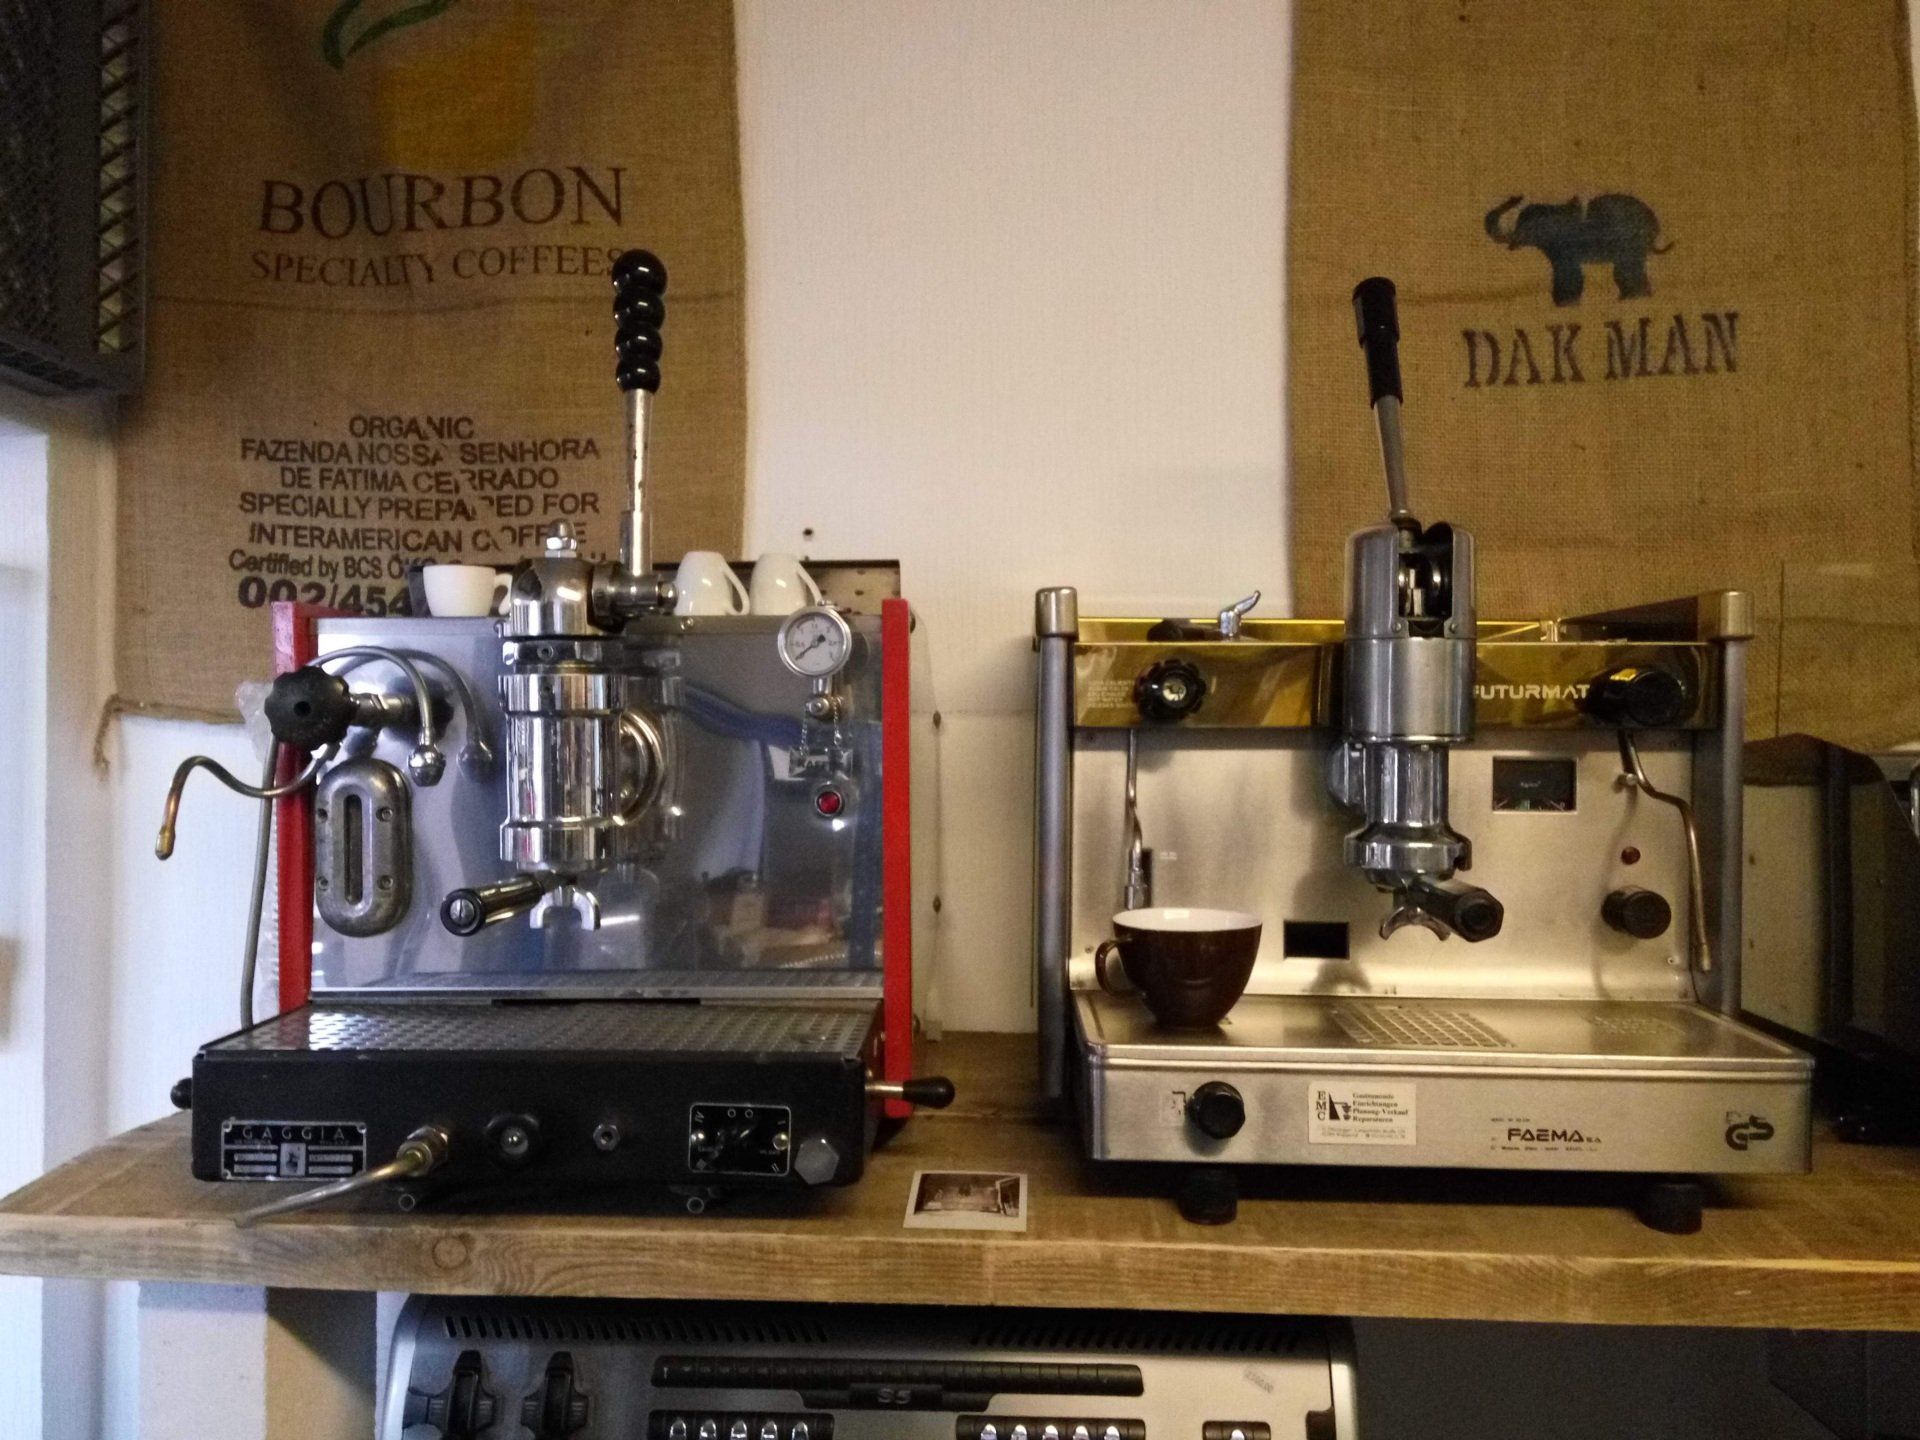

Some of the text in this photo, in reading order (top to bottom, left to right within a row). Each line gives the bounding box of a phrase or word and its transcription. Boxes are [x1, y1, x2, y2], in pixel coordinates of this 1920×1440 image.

[259, 165, 628, 240] BOURBON
[251, 248, 439, 288] SPECIALTY
[1461, 310, 1740, 389] DAK MAN
[349, 415, 475, 440] ORGANIC
[240, 438, 353, 465] FAZENDA
[459, 437, 600, 465] SENHORA
[279, 466, 560, 494] DE FATIMA CERRADO
[239, 492, 372, 519] SPECIALLY
[542, 491, 600, 516] FOR
[471, 522, 587, 552] COFFE
[229, 547, 313, 578] Certified
[318, 554, 340, 584] by
[343, 556, 383, 580] BCS
[242, 1126, 345, 1140] GAGGIA
[1507, 1128, 1584, 1143] FAEMA
